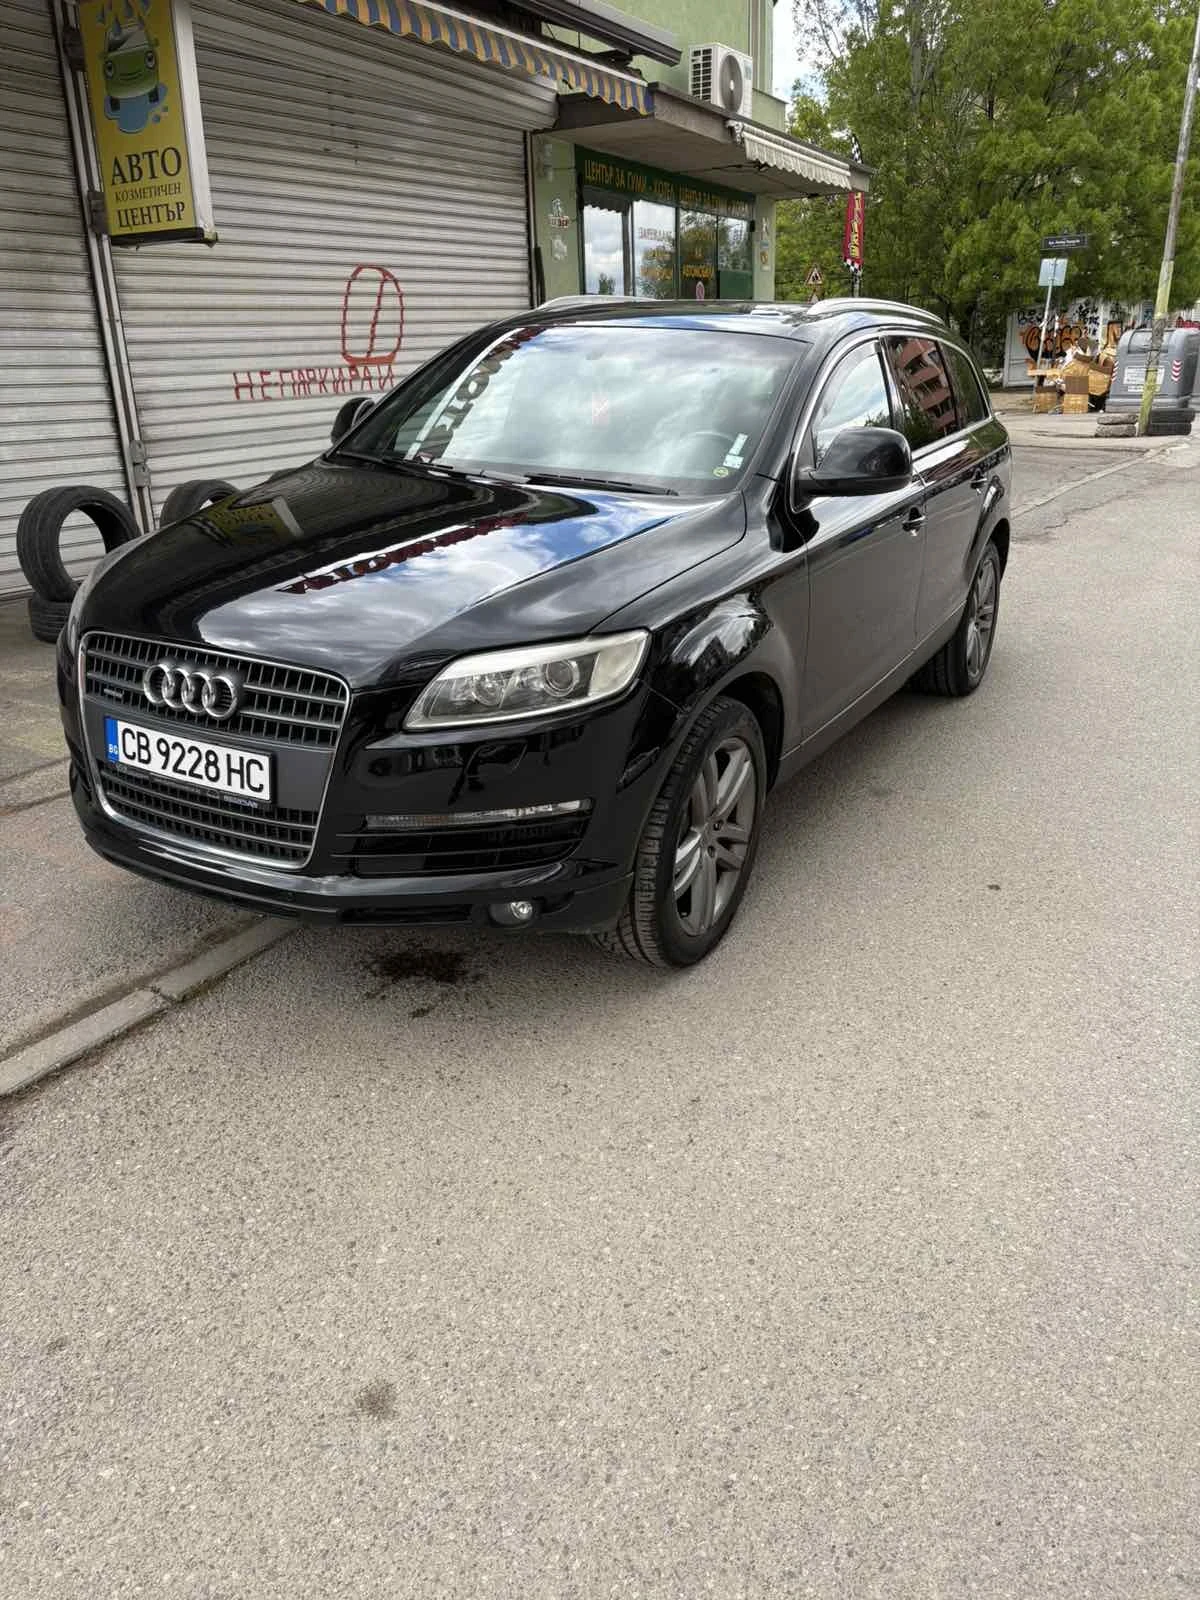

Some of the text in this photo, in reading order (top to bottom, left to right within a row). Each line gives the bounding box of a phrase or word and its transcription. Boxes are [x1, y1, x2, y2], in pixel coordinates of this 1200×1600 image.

[111, 147, 182, 185] АВТО
[115, 183, 181, 203] КОЗМЕТИЧЕН
[117, 201, 185, 231] ЦЕНТЪР
[108, 743, 119, 755] BG
[121, 727, 264, 793] CB 9228 HC
